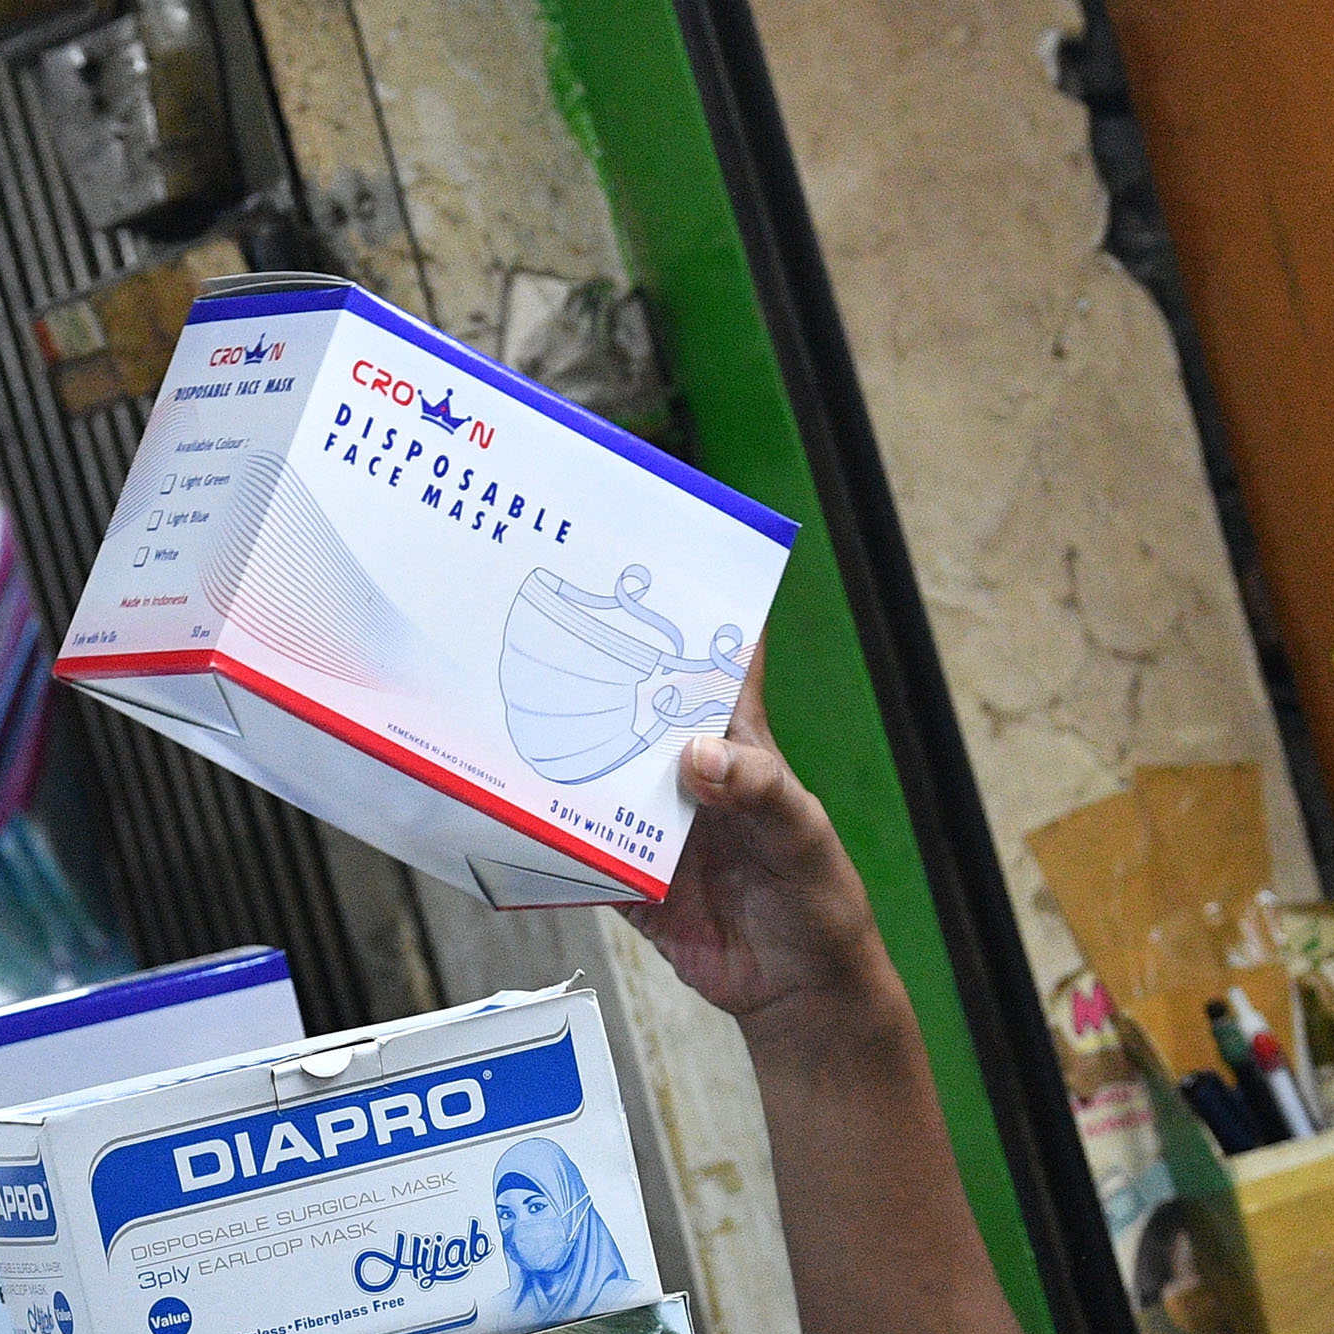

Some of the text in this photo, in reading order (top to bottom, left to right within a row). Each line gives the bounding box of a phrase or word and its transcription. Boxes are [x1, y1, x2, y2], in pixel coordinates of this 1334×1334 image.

[174, 376, 296, 402] DISPOSABLE FACE MASK
[175, 439, 211, 453] Available
[179, 472, 231, 490] Light Green
[323, 432, 510, 544] FACE MASK
[334, 402, 573, 545] DISPOSABLE
[167, 510, 210, 527] Light Blue
[153, 548, 179, 562] White
[550, 799, 656, 864] 3 ply with Tie On
[614, 806, 665, 844] 50 pcs
[172, 1079, 487, 1193] DIAPRO
[131, 1171, 457, 1261] DISPOSABLE SURGICAL MASK
[137, 1219, 378, 1291] 3ply EARLOOP MASK
[353, 1216, 493, 1293] Hijab
[150, 1311, 191, 1330] Value
[294, 1305, 368, 1332] Fiberglass
[373, 1296, 405, 1313] Free
